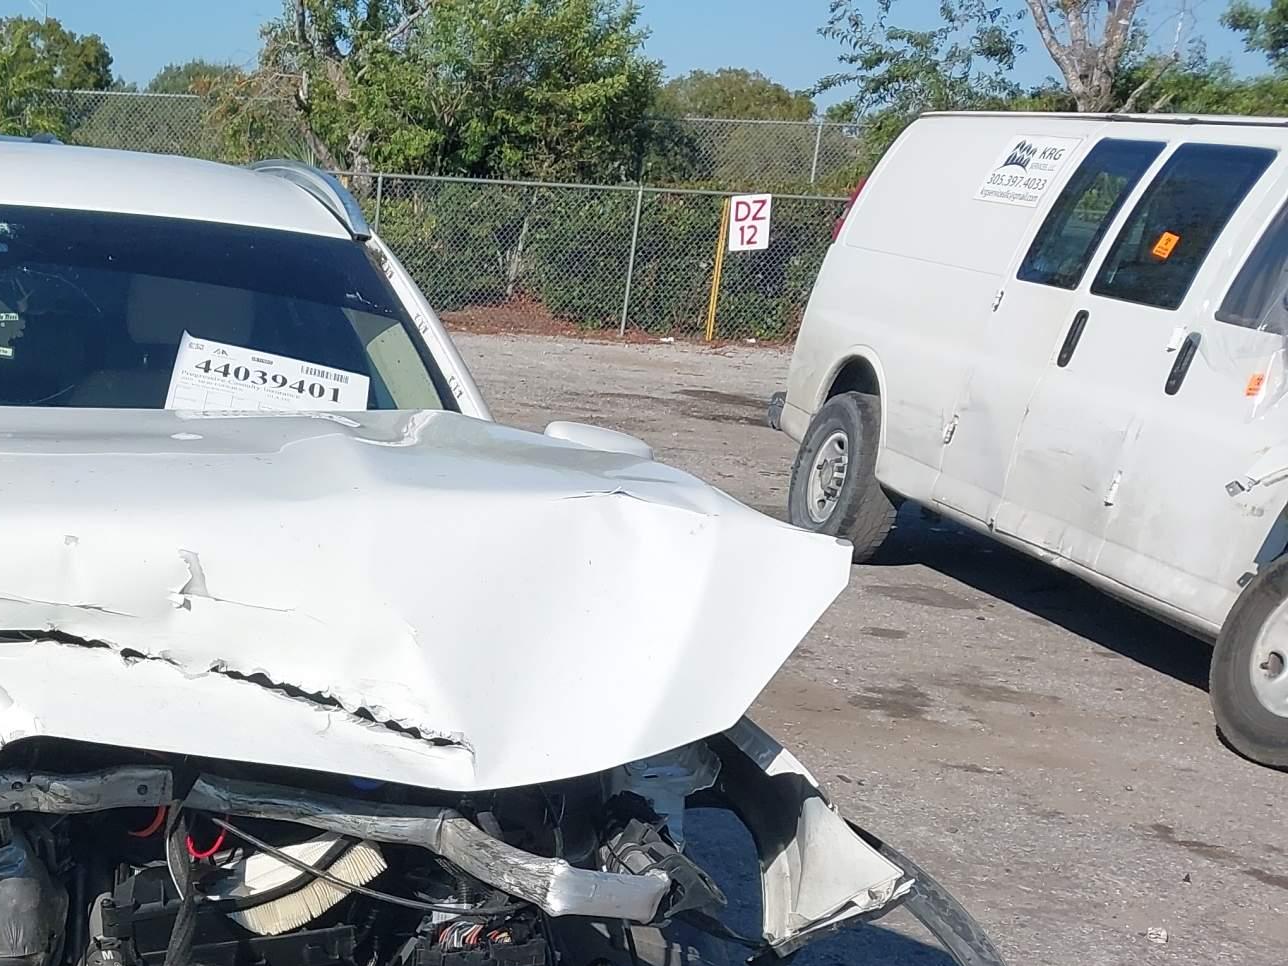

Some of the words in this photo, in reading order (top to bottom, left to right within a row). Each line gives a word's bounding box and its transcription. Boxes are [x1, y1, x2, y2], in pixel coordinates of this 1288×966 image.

[1038, 146, 1066, 161] KRG
[986, 173, 1048, 191] 305.397.4033
[735, 199, 767, 222] DZ
[738, 225, 758, 246] 12
[194, 358, 343, 404] 44039401
[101, 949, 114, 960] M
